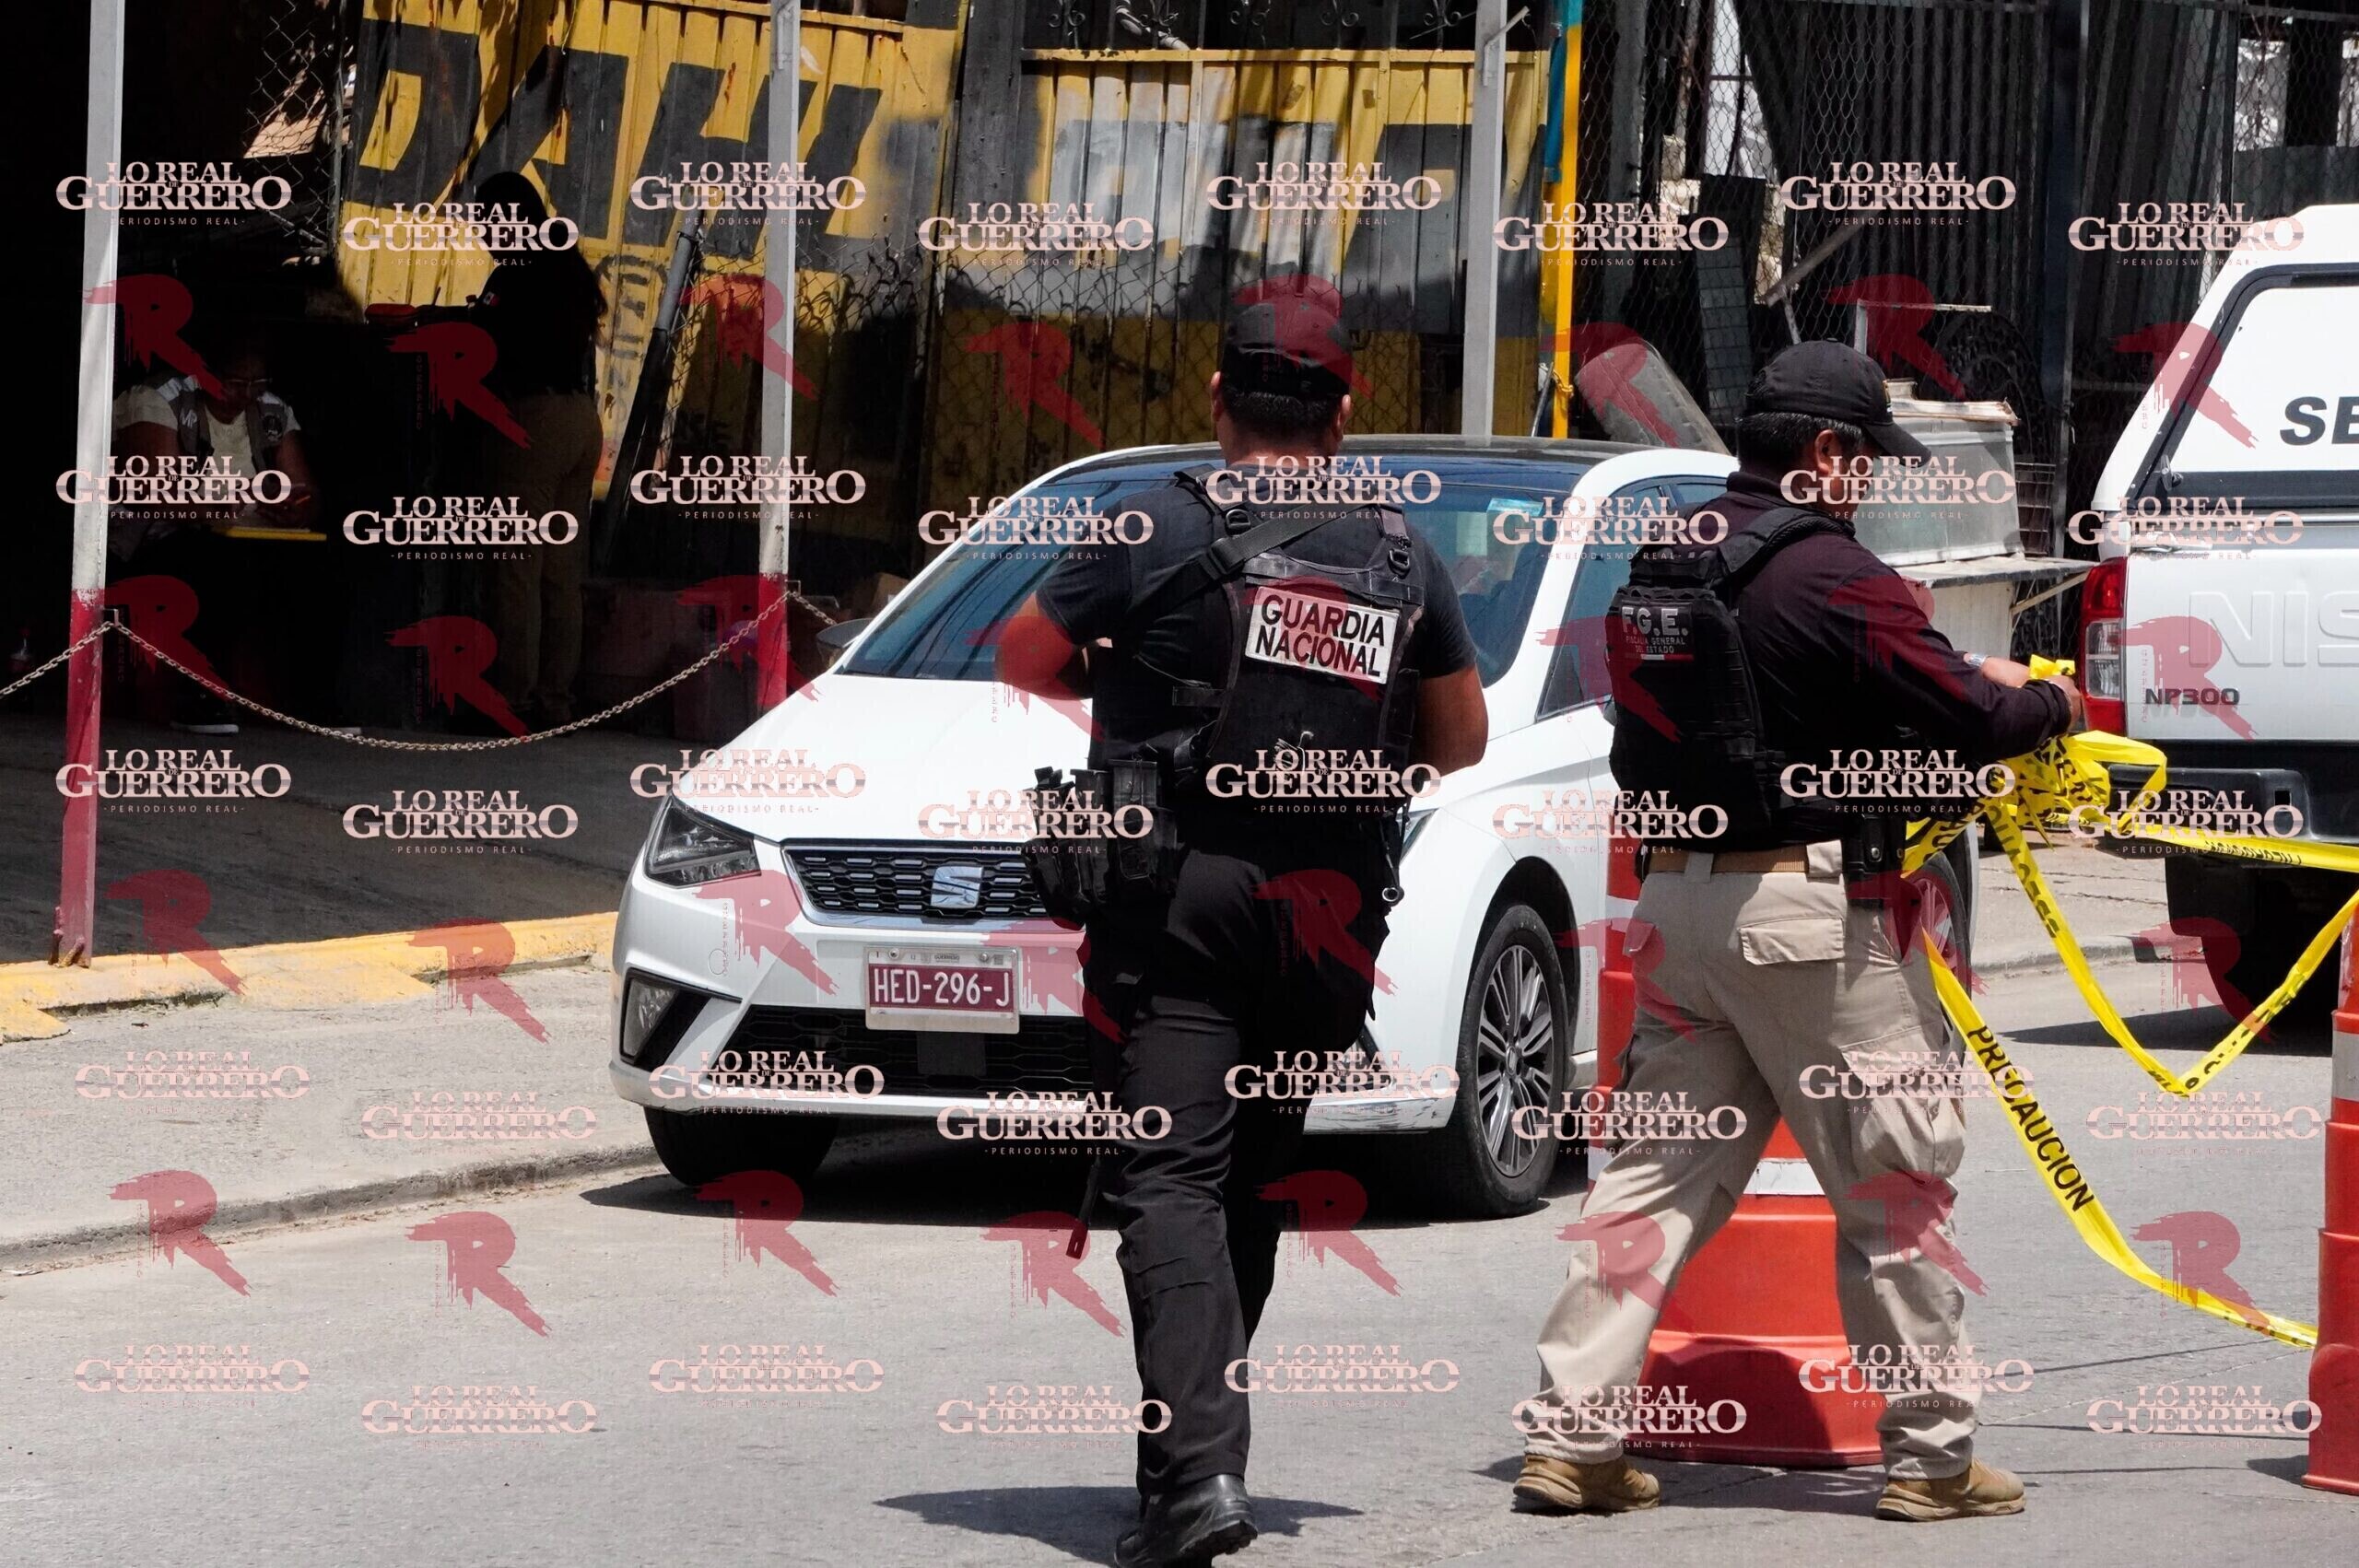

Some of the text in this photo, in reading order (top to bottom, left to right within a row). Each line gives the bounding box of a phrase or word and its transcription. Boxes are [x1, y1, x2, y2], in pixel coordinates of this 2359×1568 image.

[1262, 595, 1384, 646] GUARDIA
[1255, 625, 1380, 677] NACIONAL
[2145, 688, 2240, 705] NP300
[874, 968, 1010, 1007] HED-296-J
